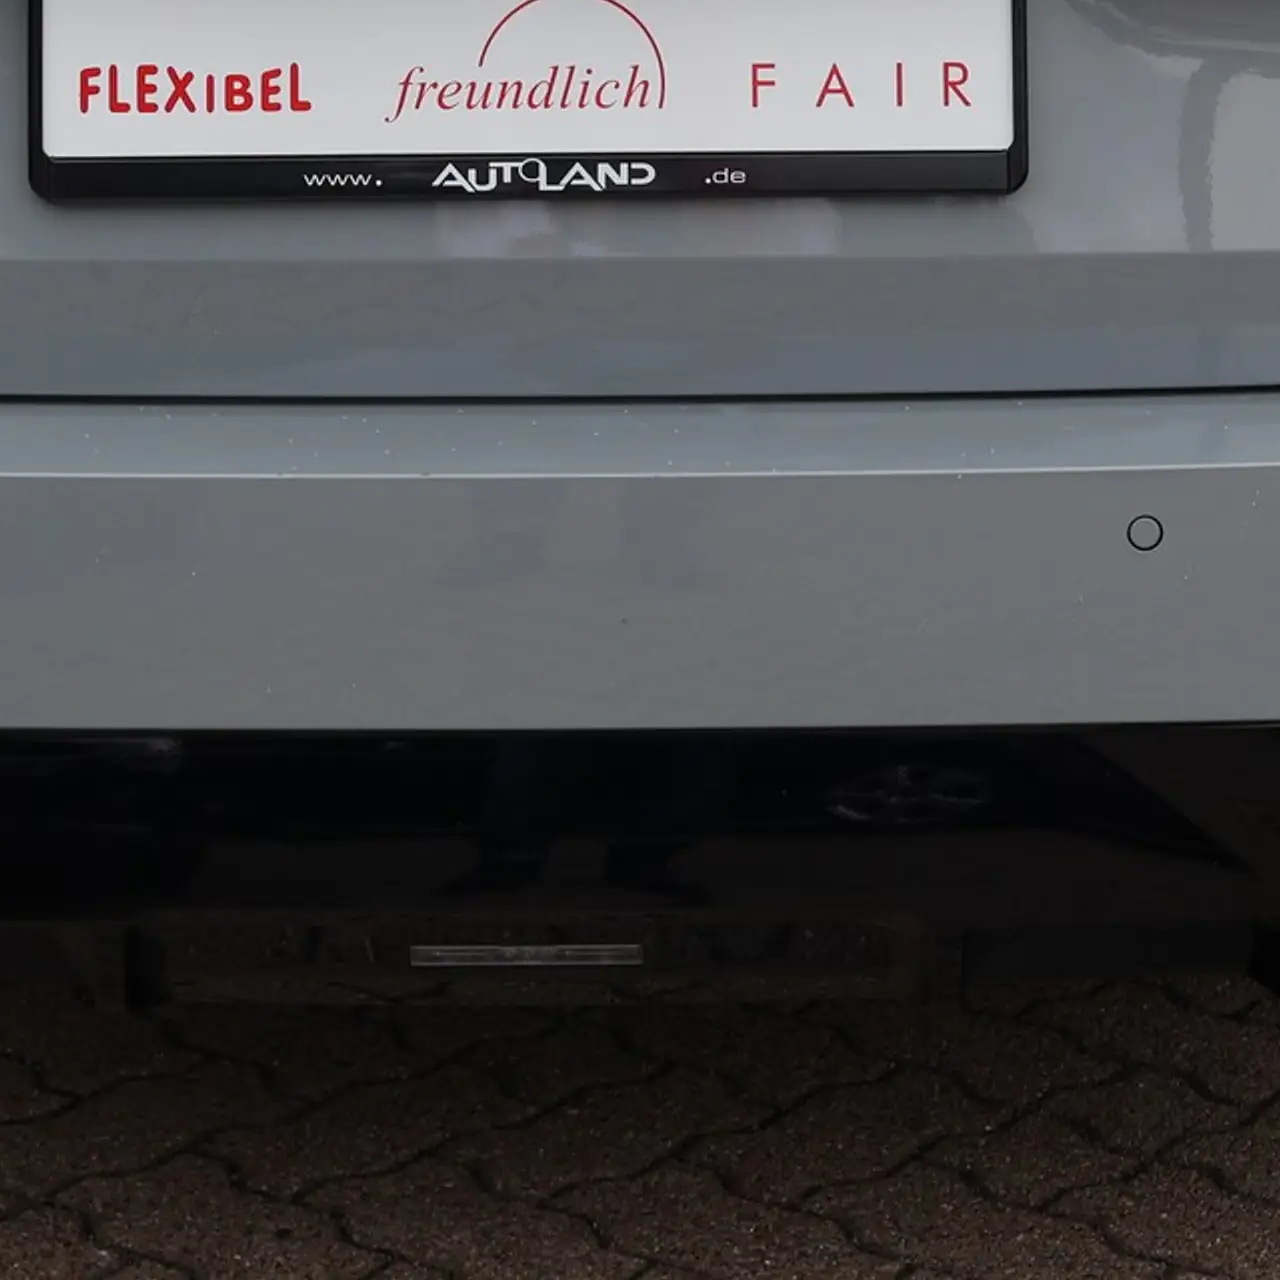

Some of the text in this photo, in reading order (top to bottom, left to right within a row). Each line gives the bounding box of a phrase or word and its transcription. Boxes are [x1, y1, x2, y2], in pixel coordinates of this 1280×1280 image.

[79, 61, 972, 123] FLEXIBEL freundlich FAIR
[303, 157, 748, 193] www. AUTOLAND .de
